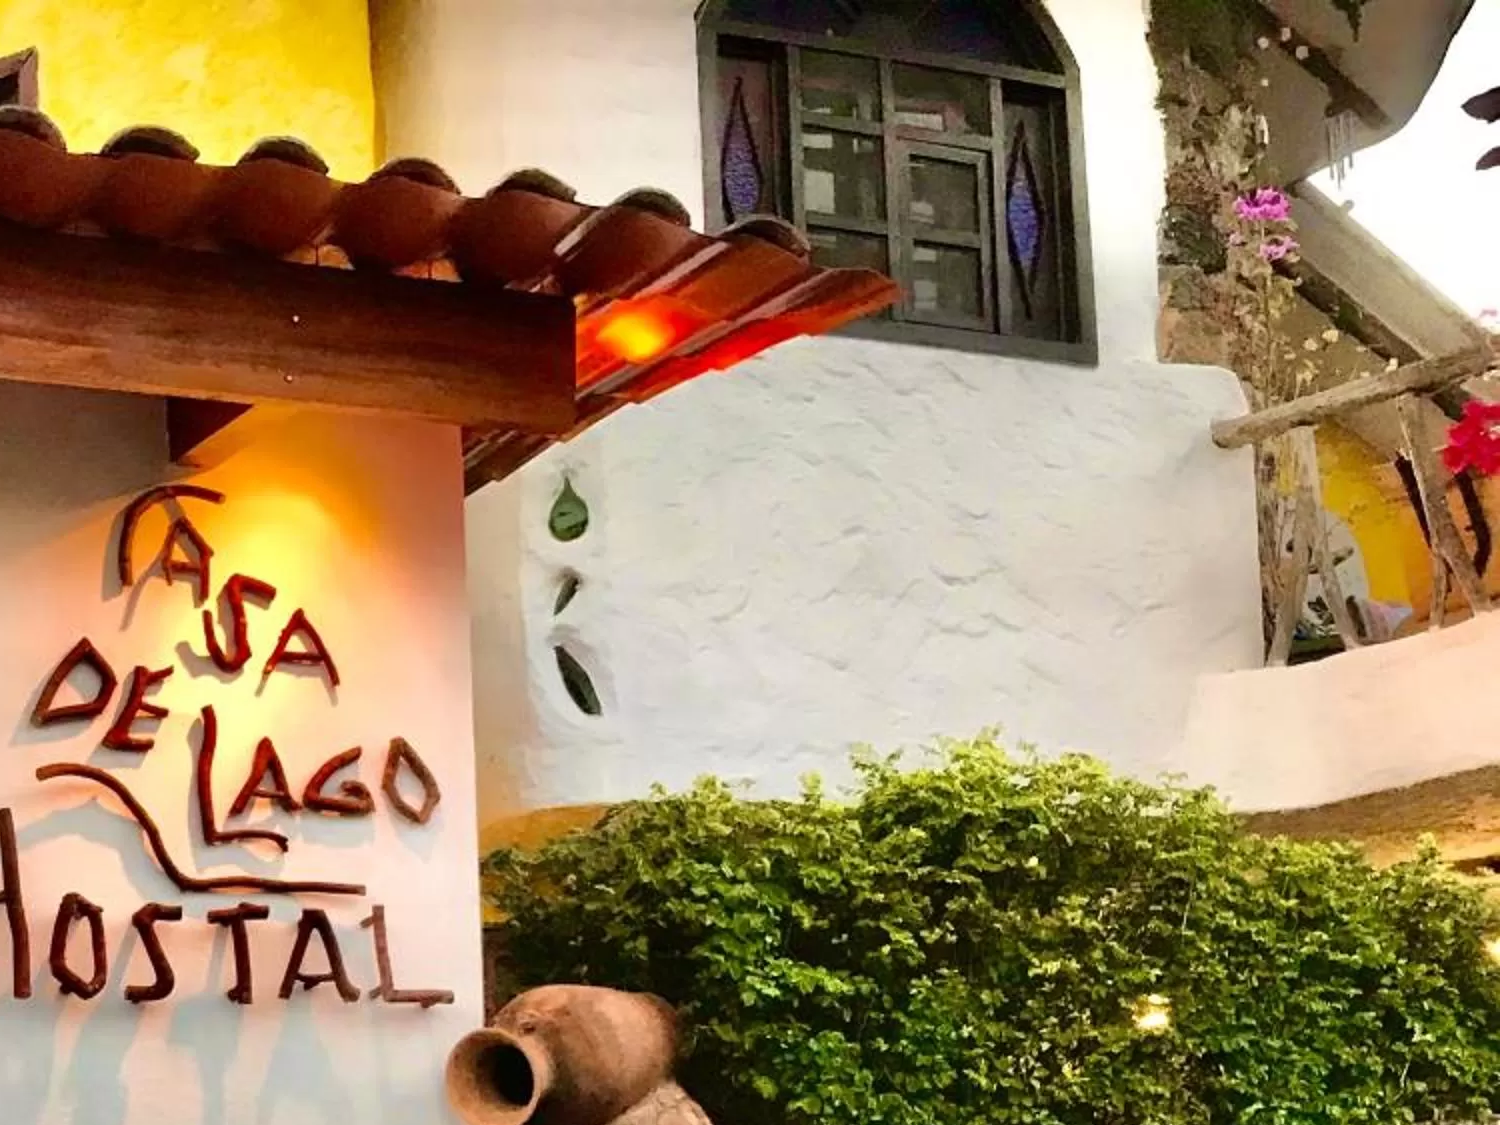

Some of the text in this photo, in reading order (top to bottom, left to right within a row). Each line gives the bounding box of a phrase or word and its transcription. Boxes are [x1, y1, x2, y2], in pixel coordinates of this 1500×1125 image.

[119, 484, 340, 687] CASA
[31, 637, 441, 852] DE LAGO
